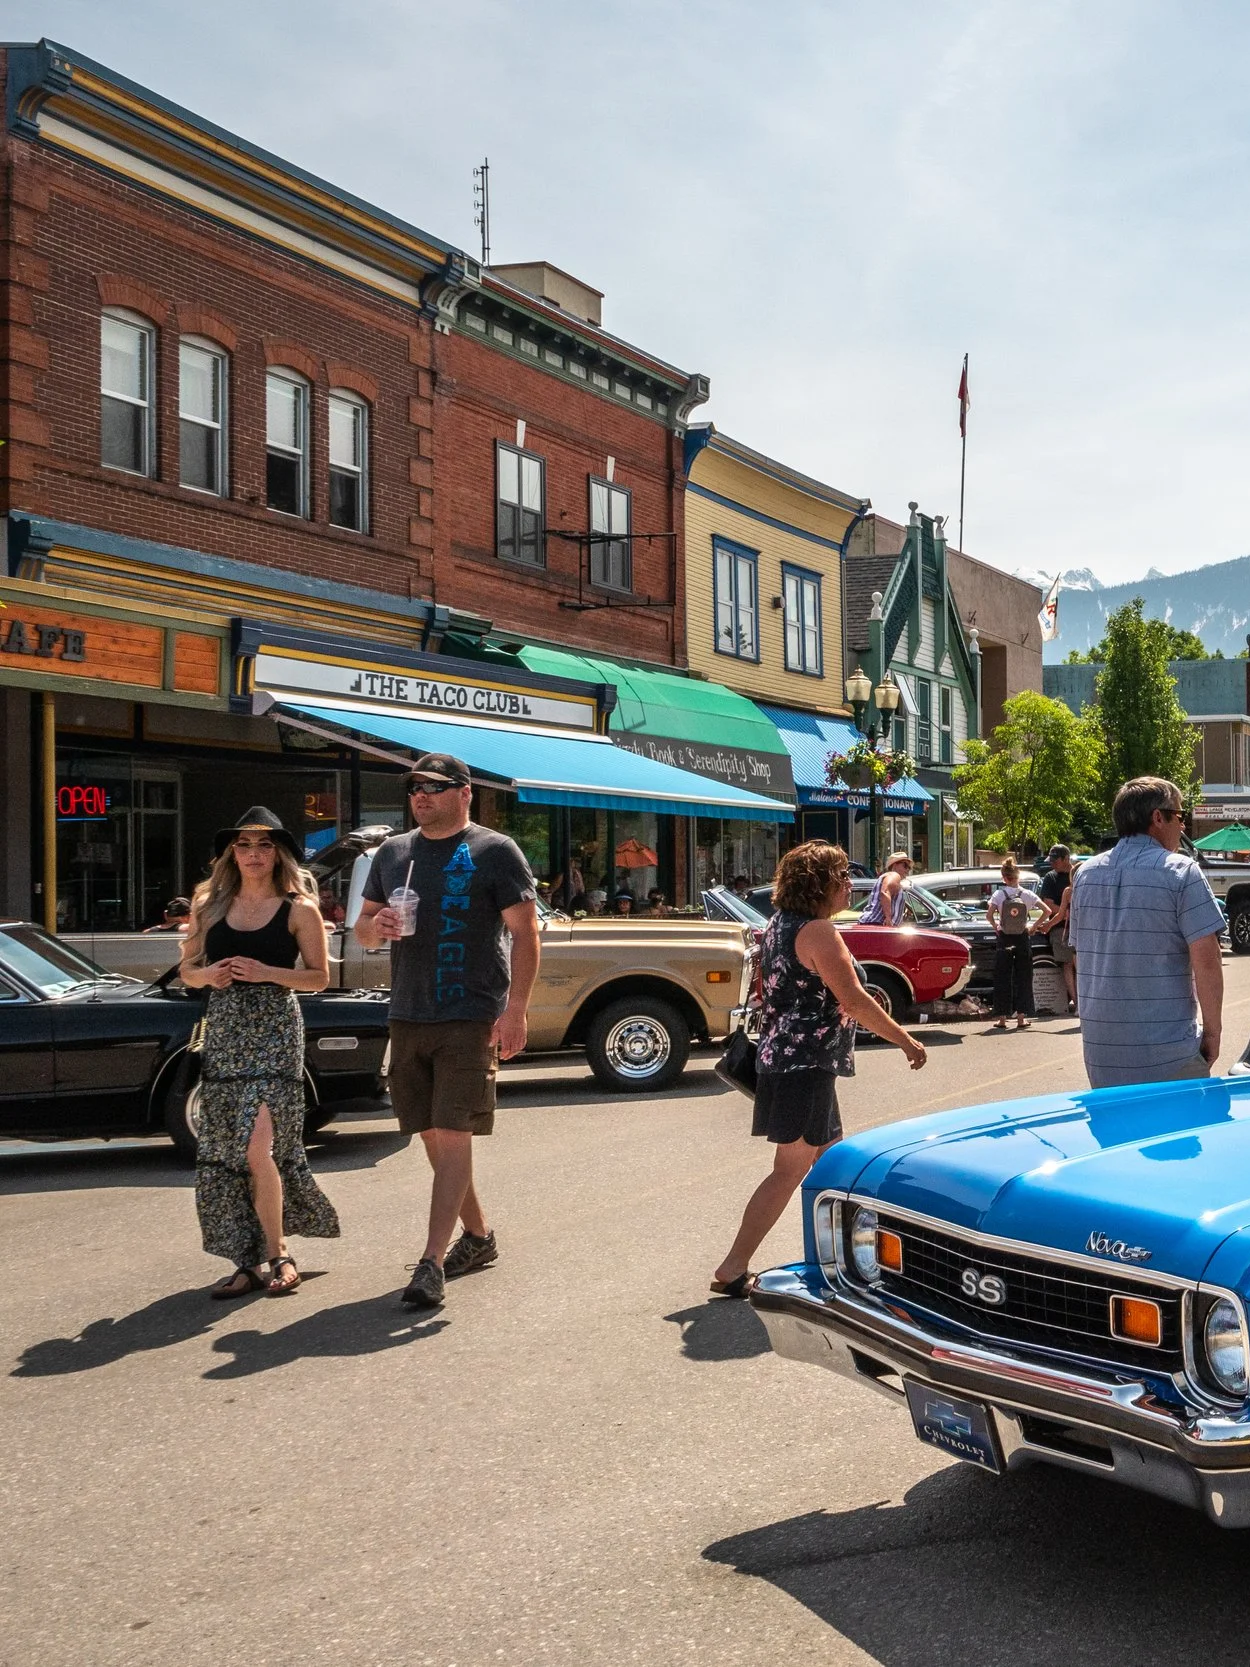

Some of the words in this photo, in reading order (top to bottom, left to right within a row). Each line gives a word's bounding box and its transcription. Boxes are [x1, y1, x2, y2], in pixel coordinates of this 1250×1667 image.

[365, 673, 408, 701] THE
[416, 681, 468, 708] TACO
[473, 689, 520, 715] CLUB
[686, 746, 748, 783] Serendipity
[746, 754, 772, 785] Shop
[57, 786, 106, 815] OPEN
[1085, 1230, 1131, 1261] Nova
[961, 1268, 1006, 1305] SS
[923, 1425, 985, 1458] CHEVROLET
